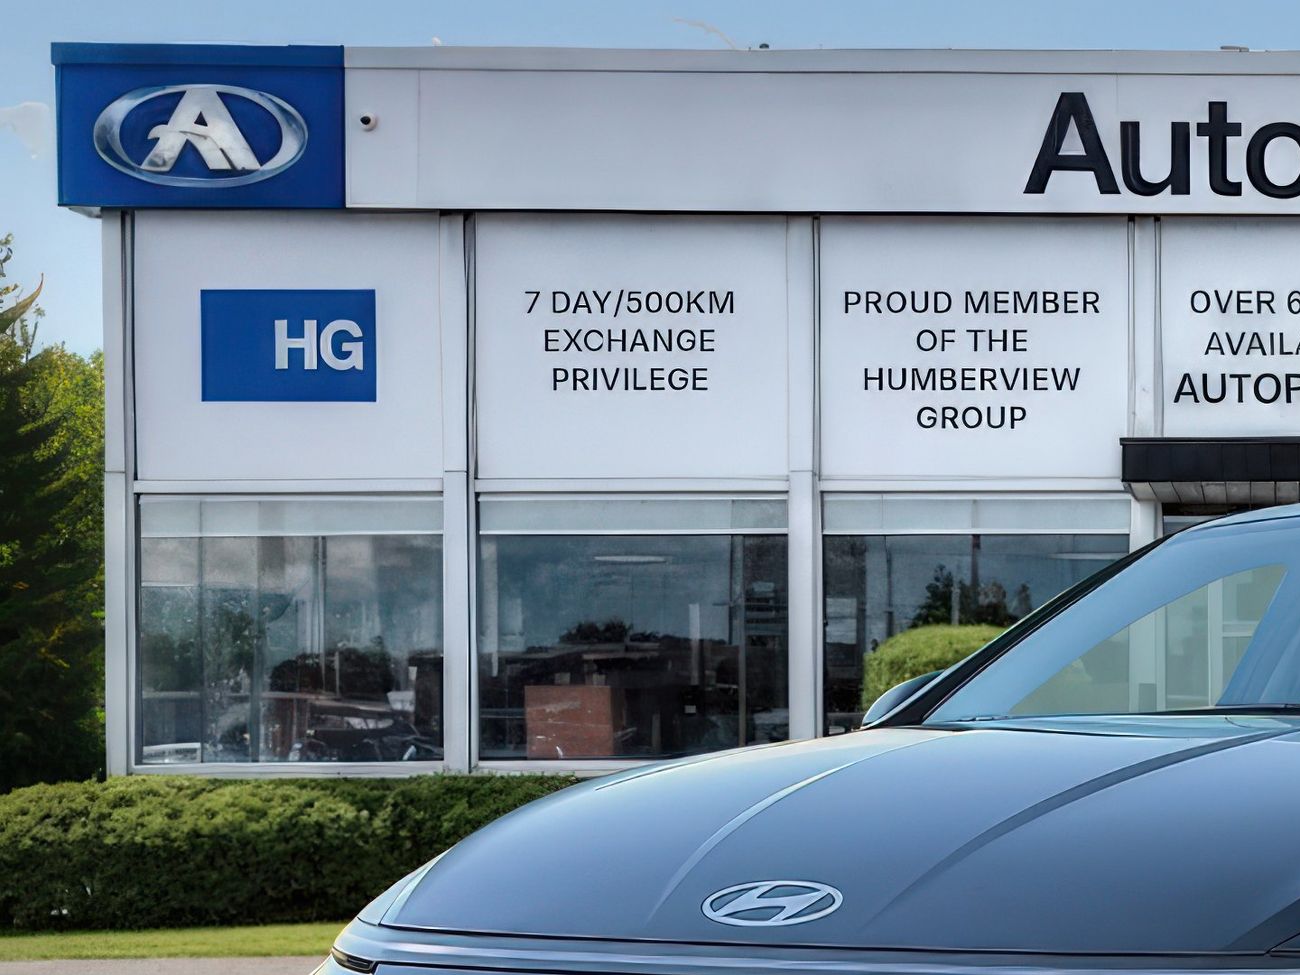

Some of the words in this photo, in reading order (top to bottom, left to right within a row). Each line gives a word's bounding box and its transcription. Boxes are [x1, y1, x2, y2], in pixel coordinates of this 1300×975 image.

[524, 290, 541, 314] 7
[551, 289, 735, 318] DAY/500KM
[844, 290, 952, 315] PROUD
[964, 290, 1101, 315] MEMBER
[1190, 289, 1276, 315] OVER
[274, 319, 364, 371] HG
[544, 328, 716, 353] EXCHANGE
[916, 329, 956, 353] OF
[966, 329, 1028, 353] THE
[552, 367, 709, 392] PRIVILEGE
[864, 367, 1082, 392] HUMBERVIEW
[916, 406, 1027, 430] GROUP
